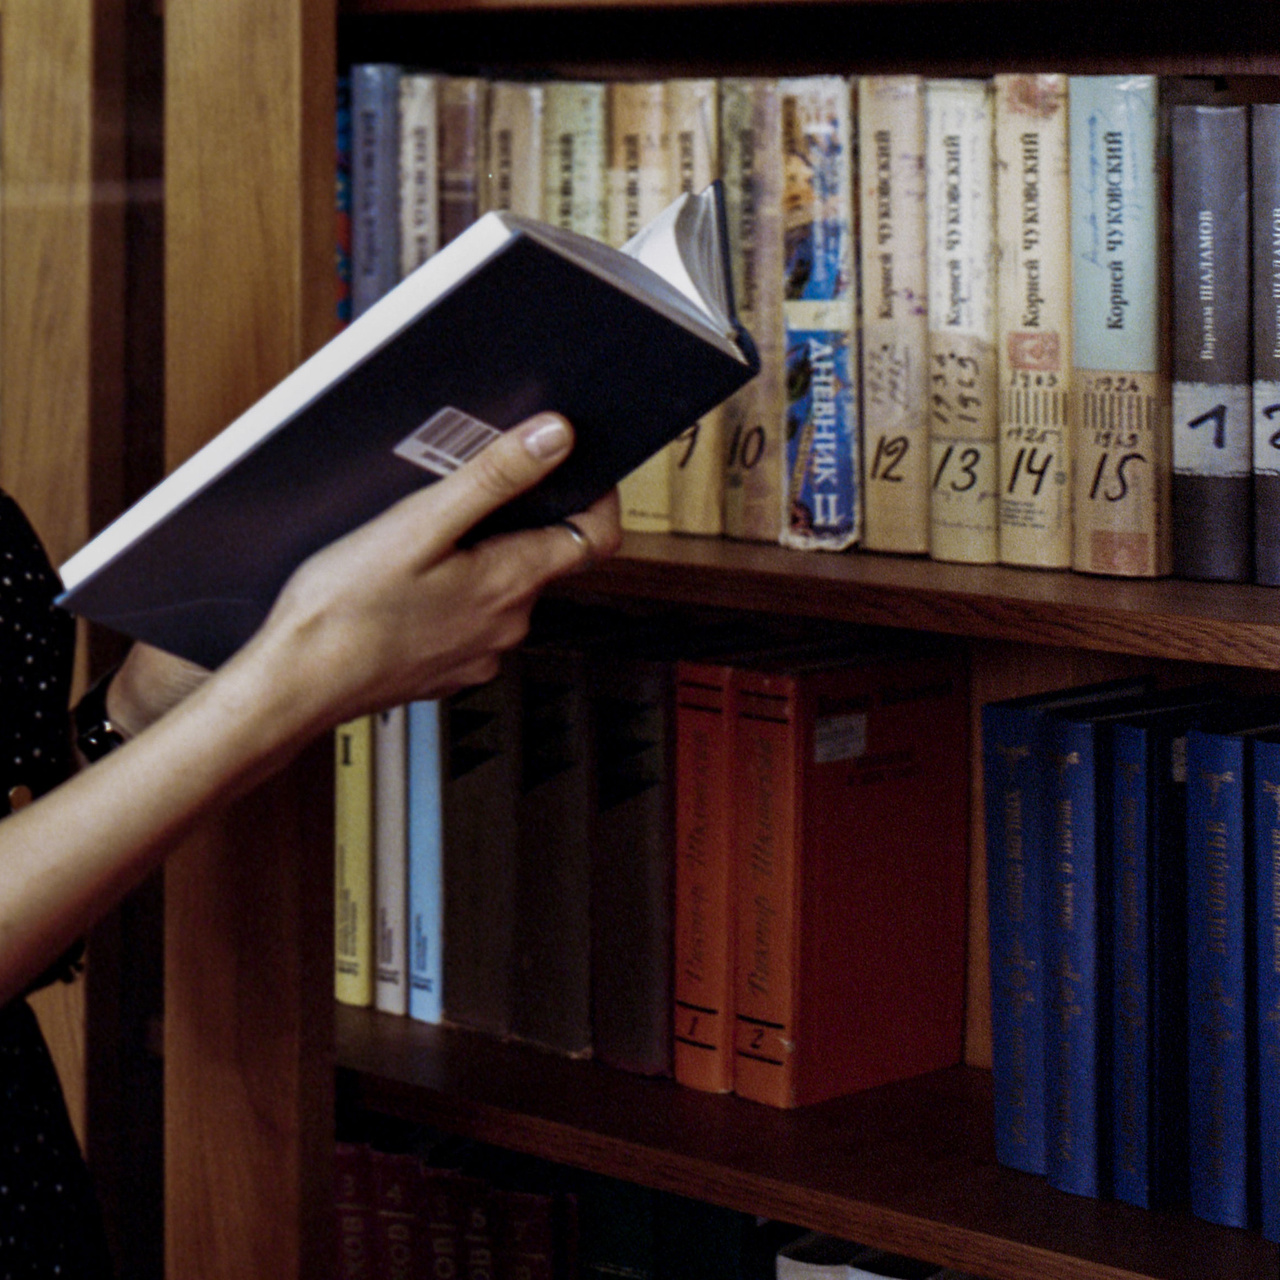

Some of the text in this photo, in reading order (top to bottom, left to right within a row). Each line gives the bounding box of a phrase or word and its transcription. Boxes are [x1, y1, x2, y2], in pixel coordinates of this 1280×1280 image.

[875, 130, 897, 319] Корней ЧУКОВСКИЙ
[944, 134, 968, 326] Корней ЧУКОВСКИЙ
[1021, 132, 1045, 328] Корней ЧУКОВСКИЙ
[1103, 130, 1129, 330] Корней ЧУКОВСКИЙ
[1198, 210, 1217, 359] Варлам ШАЛАМОВ
[809, 338, 838, 485] ДНЕВНИК
[1187, 404, 1227, 449] 1
[727, 423, 766, 470] 10
[870, 434, 910, 483] 12
[932, 445, 982, 493] 13
[1007, 447, 1053, 496] 14
[1089, 452, 1148, 503] 15
[750, 1028, 764, 1050] 2
